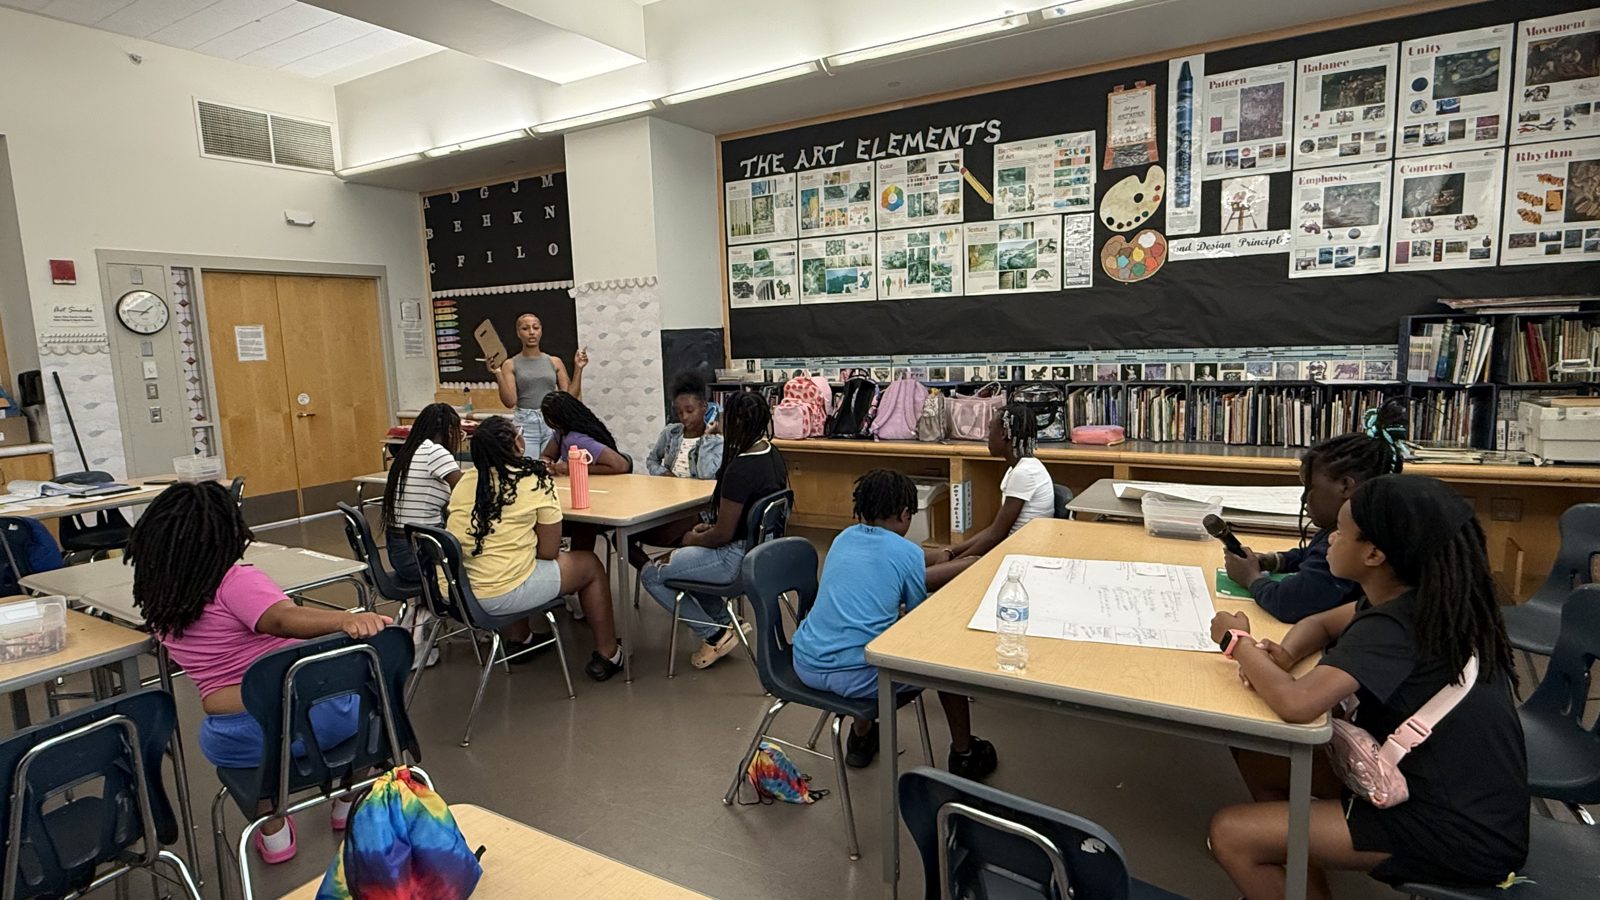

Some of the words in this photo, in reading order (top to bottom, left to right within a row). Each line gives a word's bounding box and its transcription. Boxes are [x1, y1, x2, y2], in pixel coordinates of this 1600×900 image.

[1525, 19, 1586, 37] Movement
[1407, 42, 1443, 57] Unity
[1302, 58, 1350, 74] Balance
[1208, 76, 1247, 90] Pattern
[740, 152, 786, 178] THE
[794, 140, 845, 170] ART
[856, 119, 1002, 160] ELEMENTS
[1515, 148, 1573, 164] Rhythm
[1400, 161, 1454, 174] Contrast
[540, 174, 554, 188] M
[1298, 173, 1348, 186] Emphasis
[480, 186, 489, 199] G
[511, 180, 519, 193] J
[423, 197, 431, 209] A
[450, 191, 460, 203] D
[512, 210, 523, 224] K
[544, 205, 555, 219] N
[453, 220, 462, 232] E
[482, 214, 491, 227] H
[425, 228, 434, 240] B
[548, 242, 558, 256] O
[1196, 241, 1231, 253] Design
[1238, 235, 1291, 248] Principl
[486, 251, 493, 263] I
[516, 246, 526, 258] L
[457, 255, 465, 267] F
[429, 262, 436, 274] C
